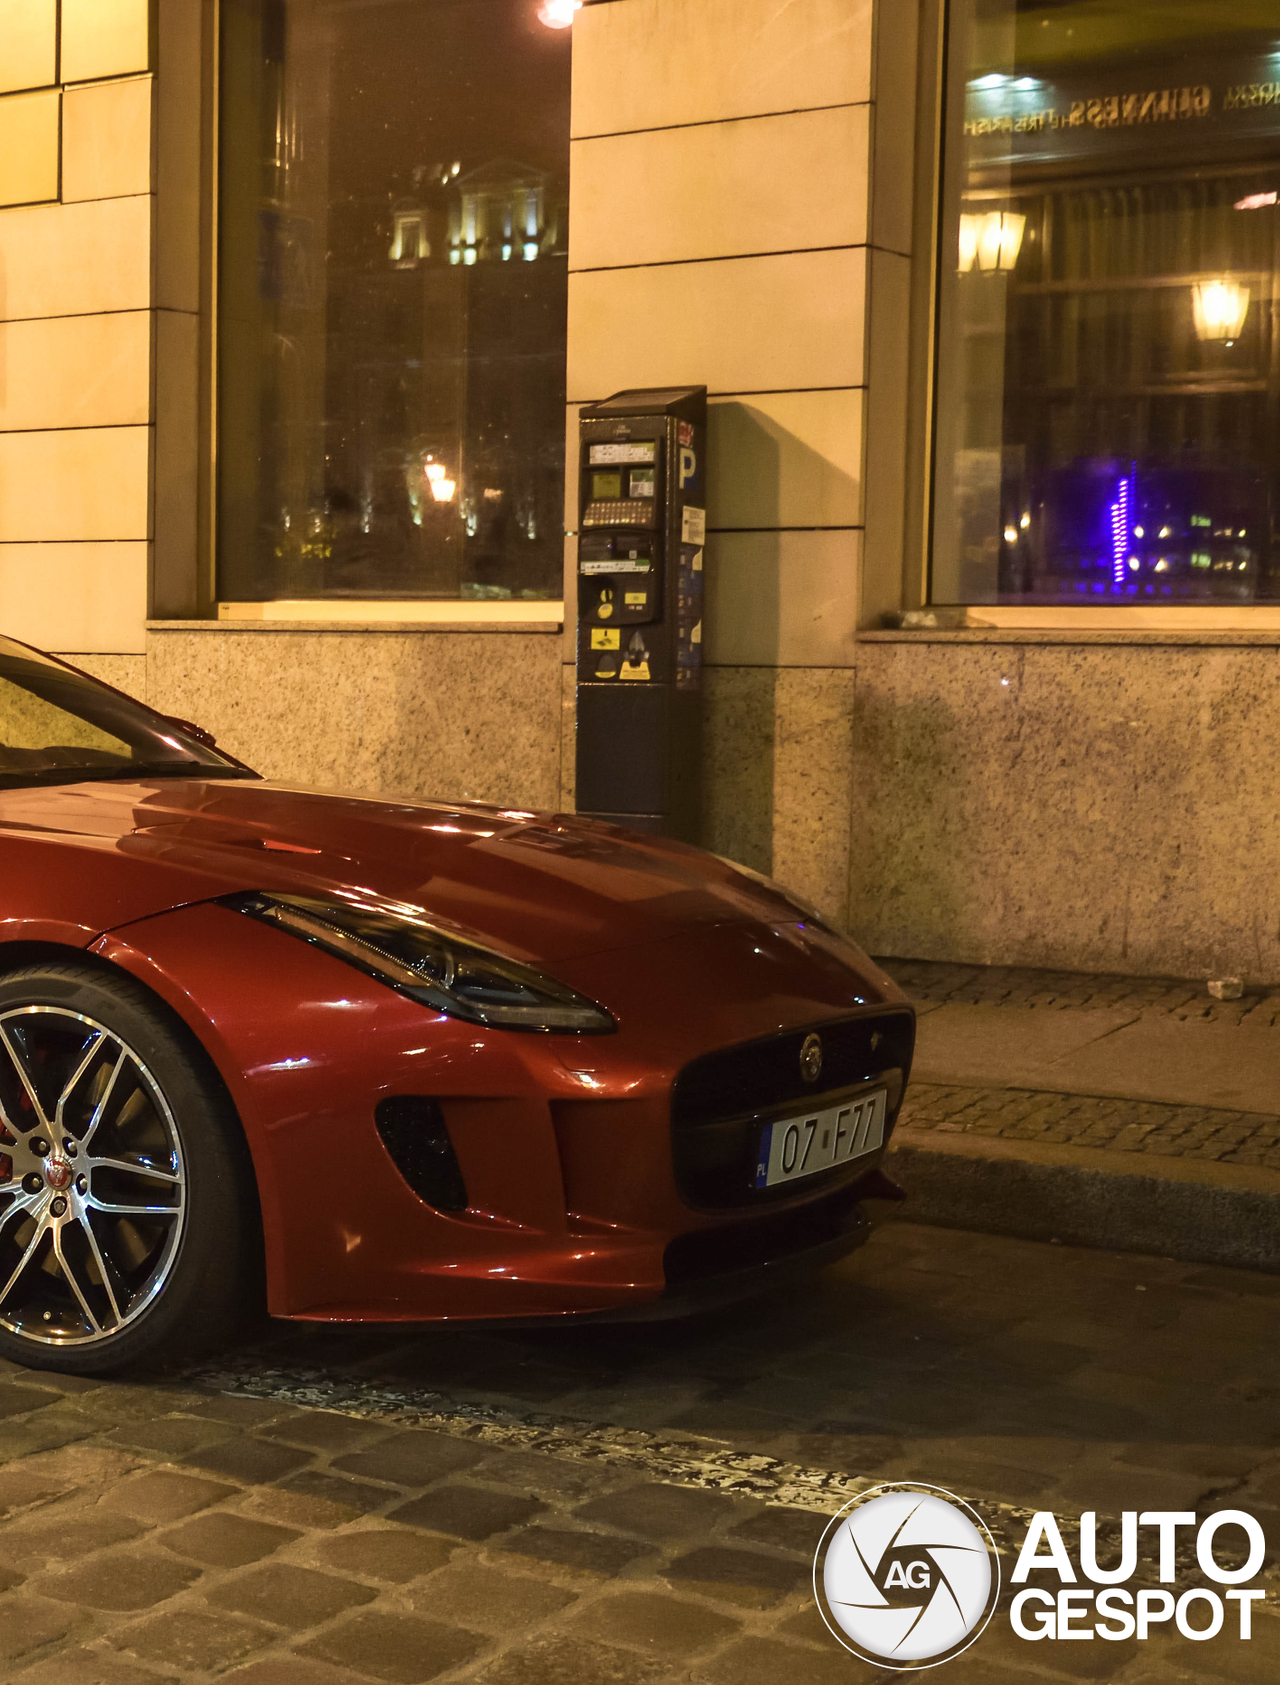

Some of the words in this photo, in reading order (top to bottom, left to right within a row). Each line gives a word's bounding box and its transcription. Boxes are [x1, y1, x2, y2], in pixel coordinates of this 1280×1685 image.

[679, 447, 696, 489] P
[832, 1097, 877, 1160] F77
[756, 1163, 767, 1178] PL
